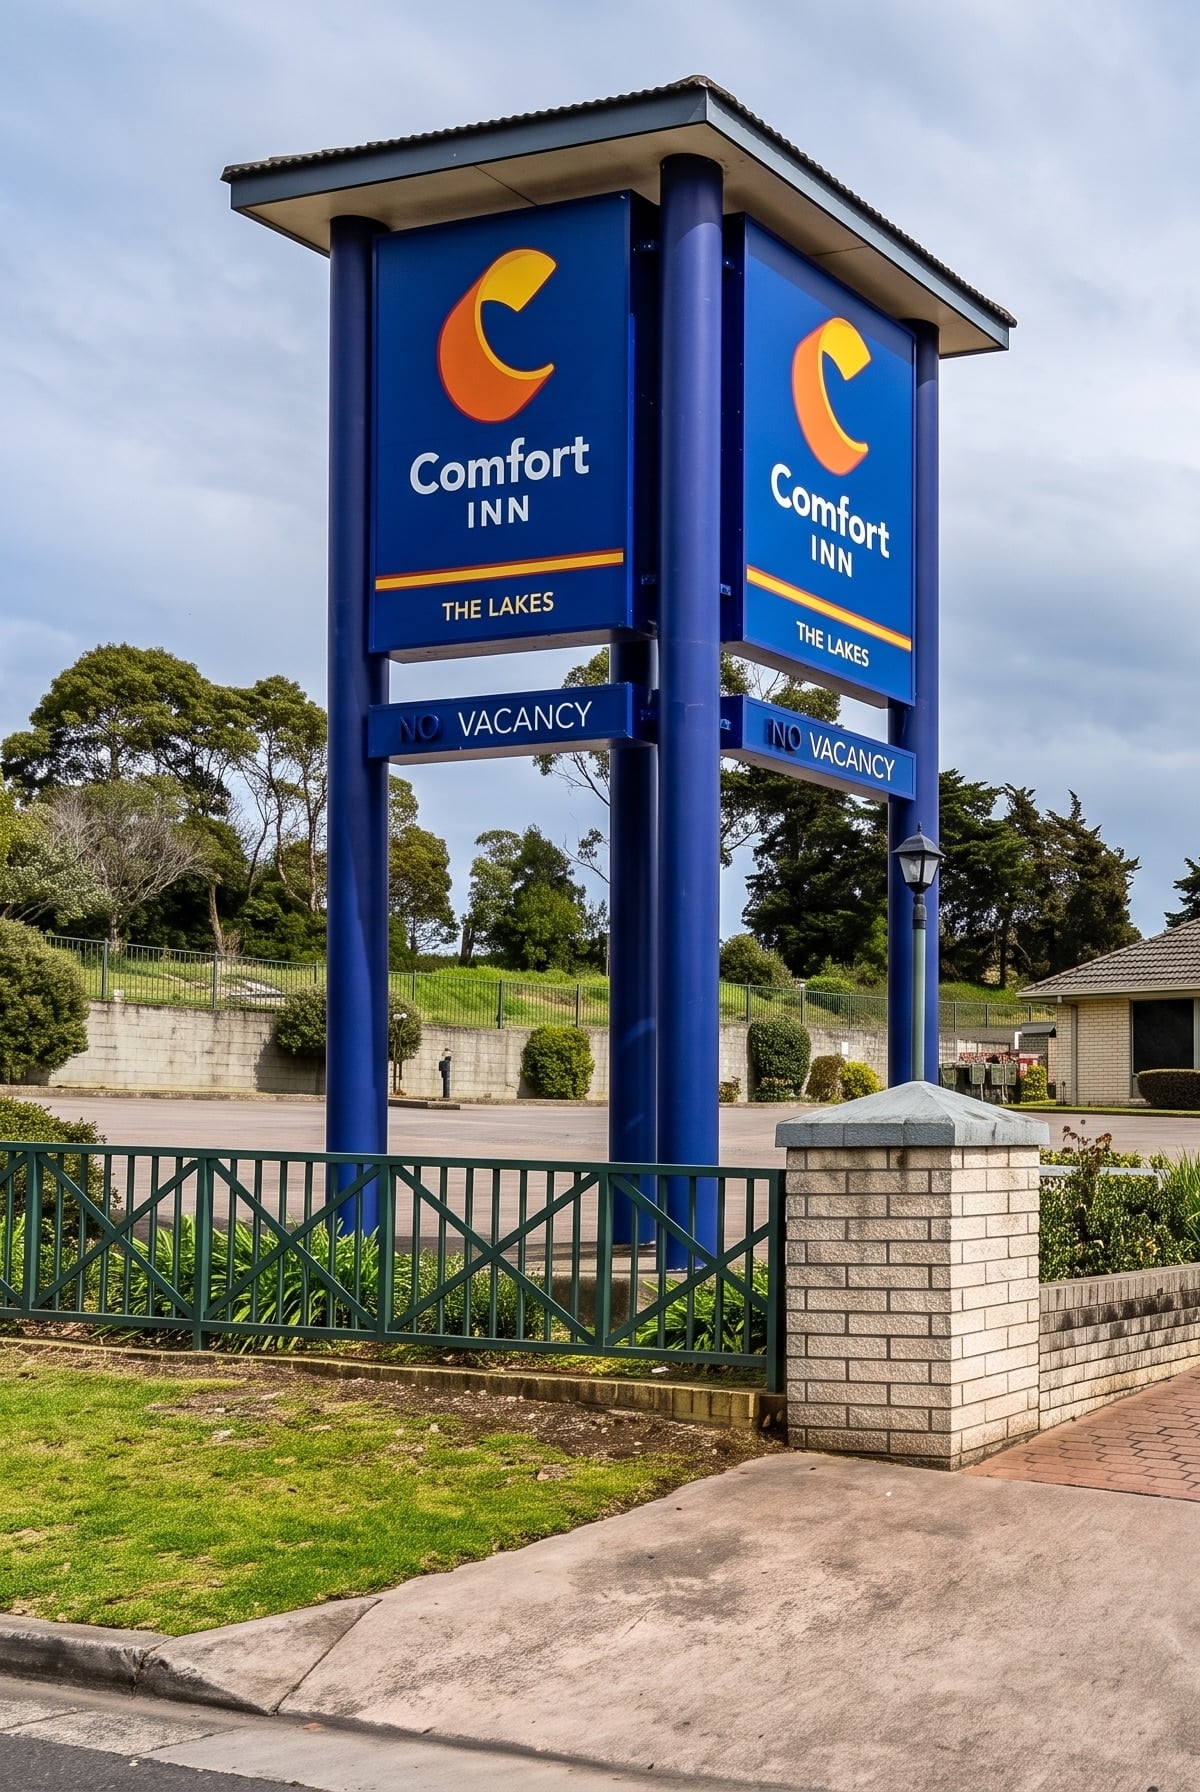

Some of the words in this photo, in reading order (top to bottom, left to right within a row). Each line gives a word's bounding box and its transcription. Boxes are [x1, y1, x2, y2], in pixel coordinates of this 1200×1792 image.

[409, 436, 590, 495] Comfort
[468, 495, 529, 529] INN
[770, 463, 890, 559] Comfort
[811, 534, 853, 578] INN
[442, 599, 482, 622] THE
[488, 591, 554, 617] LAKES
[796, 620, 824, 650] THE
[827, 634, 870, 668] LAKES
[400, 712, 441, 743] NO
[458, 701, 593, 737] VACANCY
[769, 717, 802, 751] NO
[809, 731, 895, 781] VACANCY
